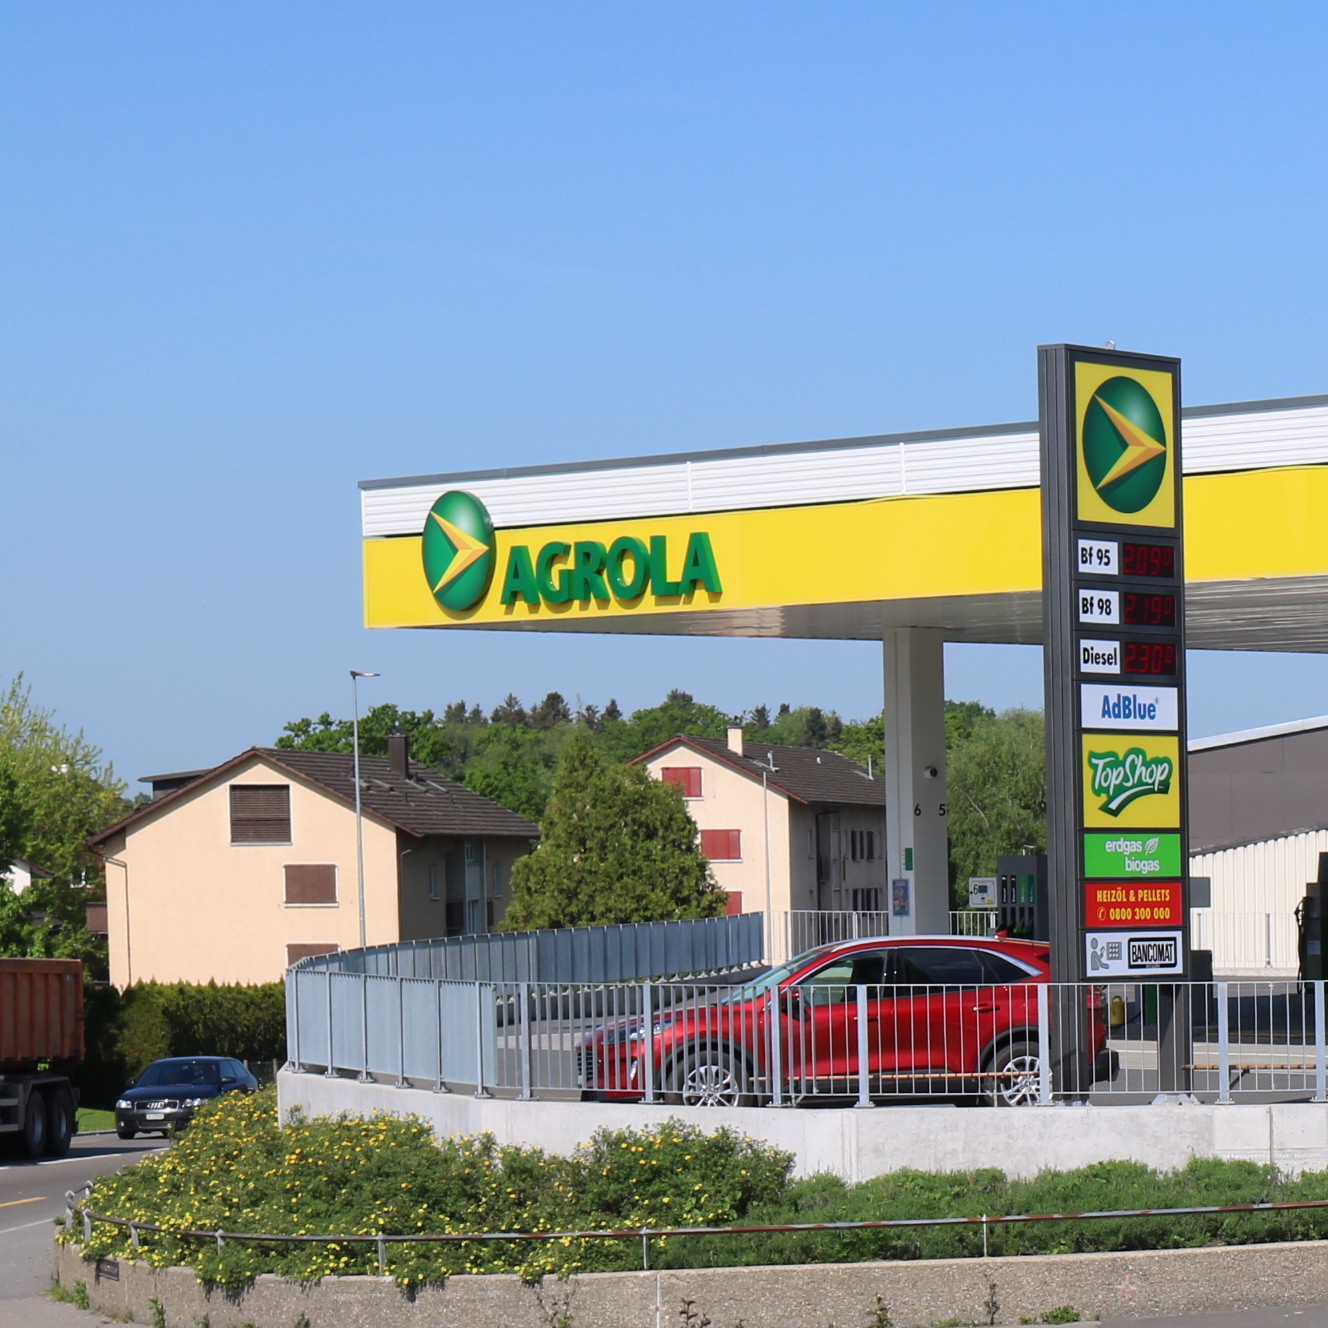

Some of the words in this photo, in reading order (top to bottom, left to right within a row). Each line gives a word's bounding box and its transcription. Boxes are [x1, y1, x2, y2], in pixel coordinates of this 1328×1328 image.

[1081, 547, 1093, 565] Bf
[1097, 548, 1111, 566] 95
[501, 532, 722, 604] AGROLA
[1082, 596, 1094, 615] Bf
[1098, 598, 1112, 616] 98
[1082, 646, 1118, 666] Diesel
[1101, 693, 1156, 720] AdBlue
[1091, 753, 1170, 796] TopShop
[1105, 837, 1142, 855] erdgas
[1125, 857, 1160, 874] biogas
[1096, 887, 1127, 902] HEIZÖL
[1129, 890, 1136, 902] &
[1138, 889, 1170, 902] PELLETS
[1109, 907, 1132, 920] 0800
[1134, 907, 1151, 920] 300
[1153, 907, 1170, 920] 000
[1131, 943, 1173, 962] BANCOMAT
